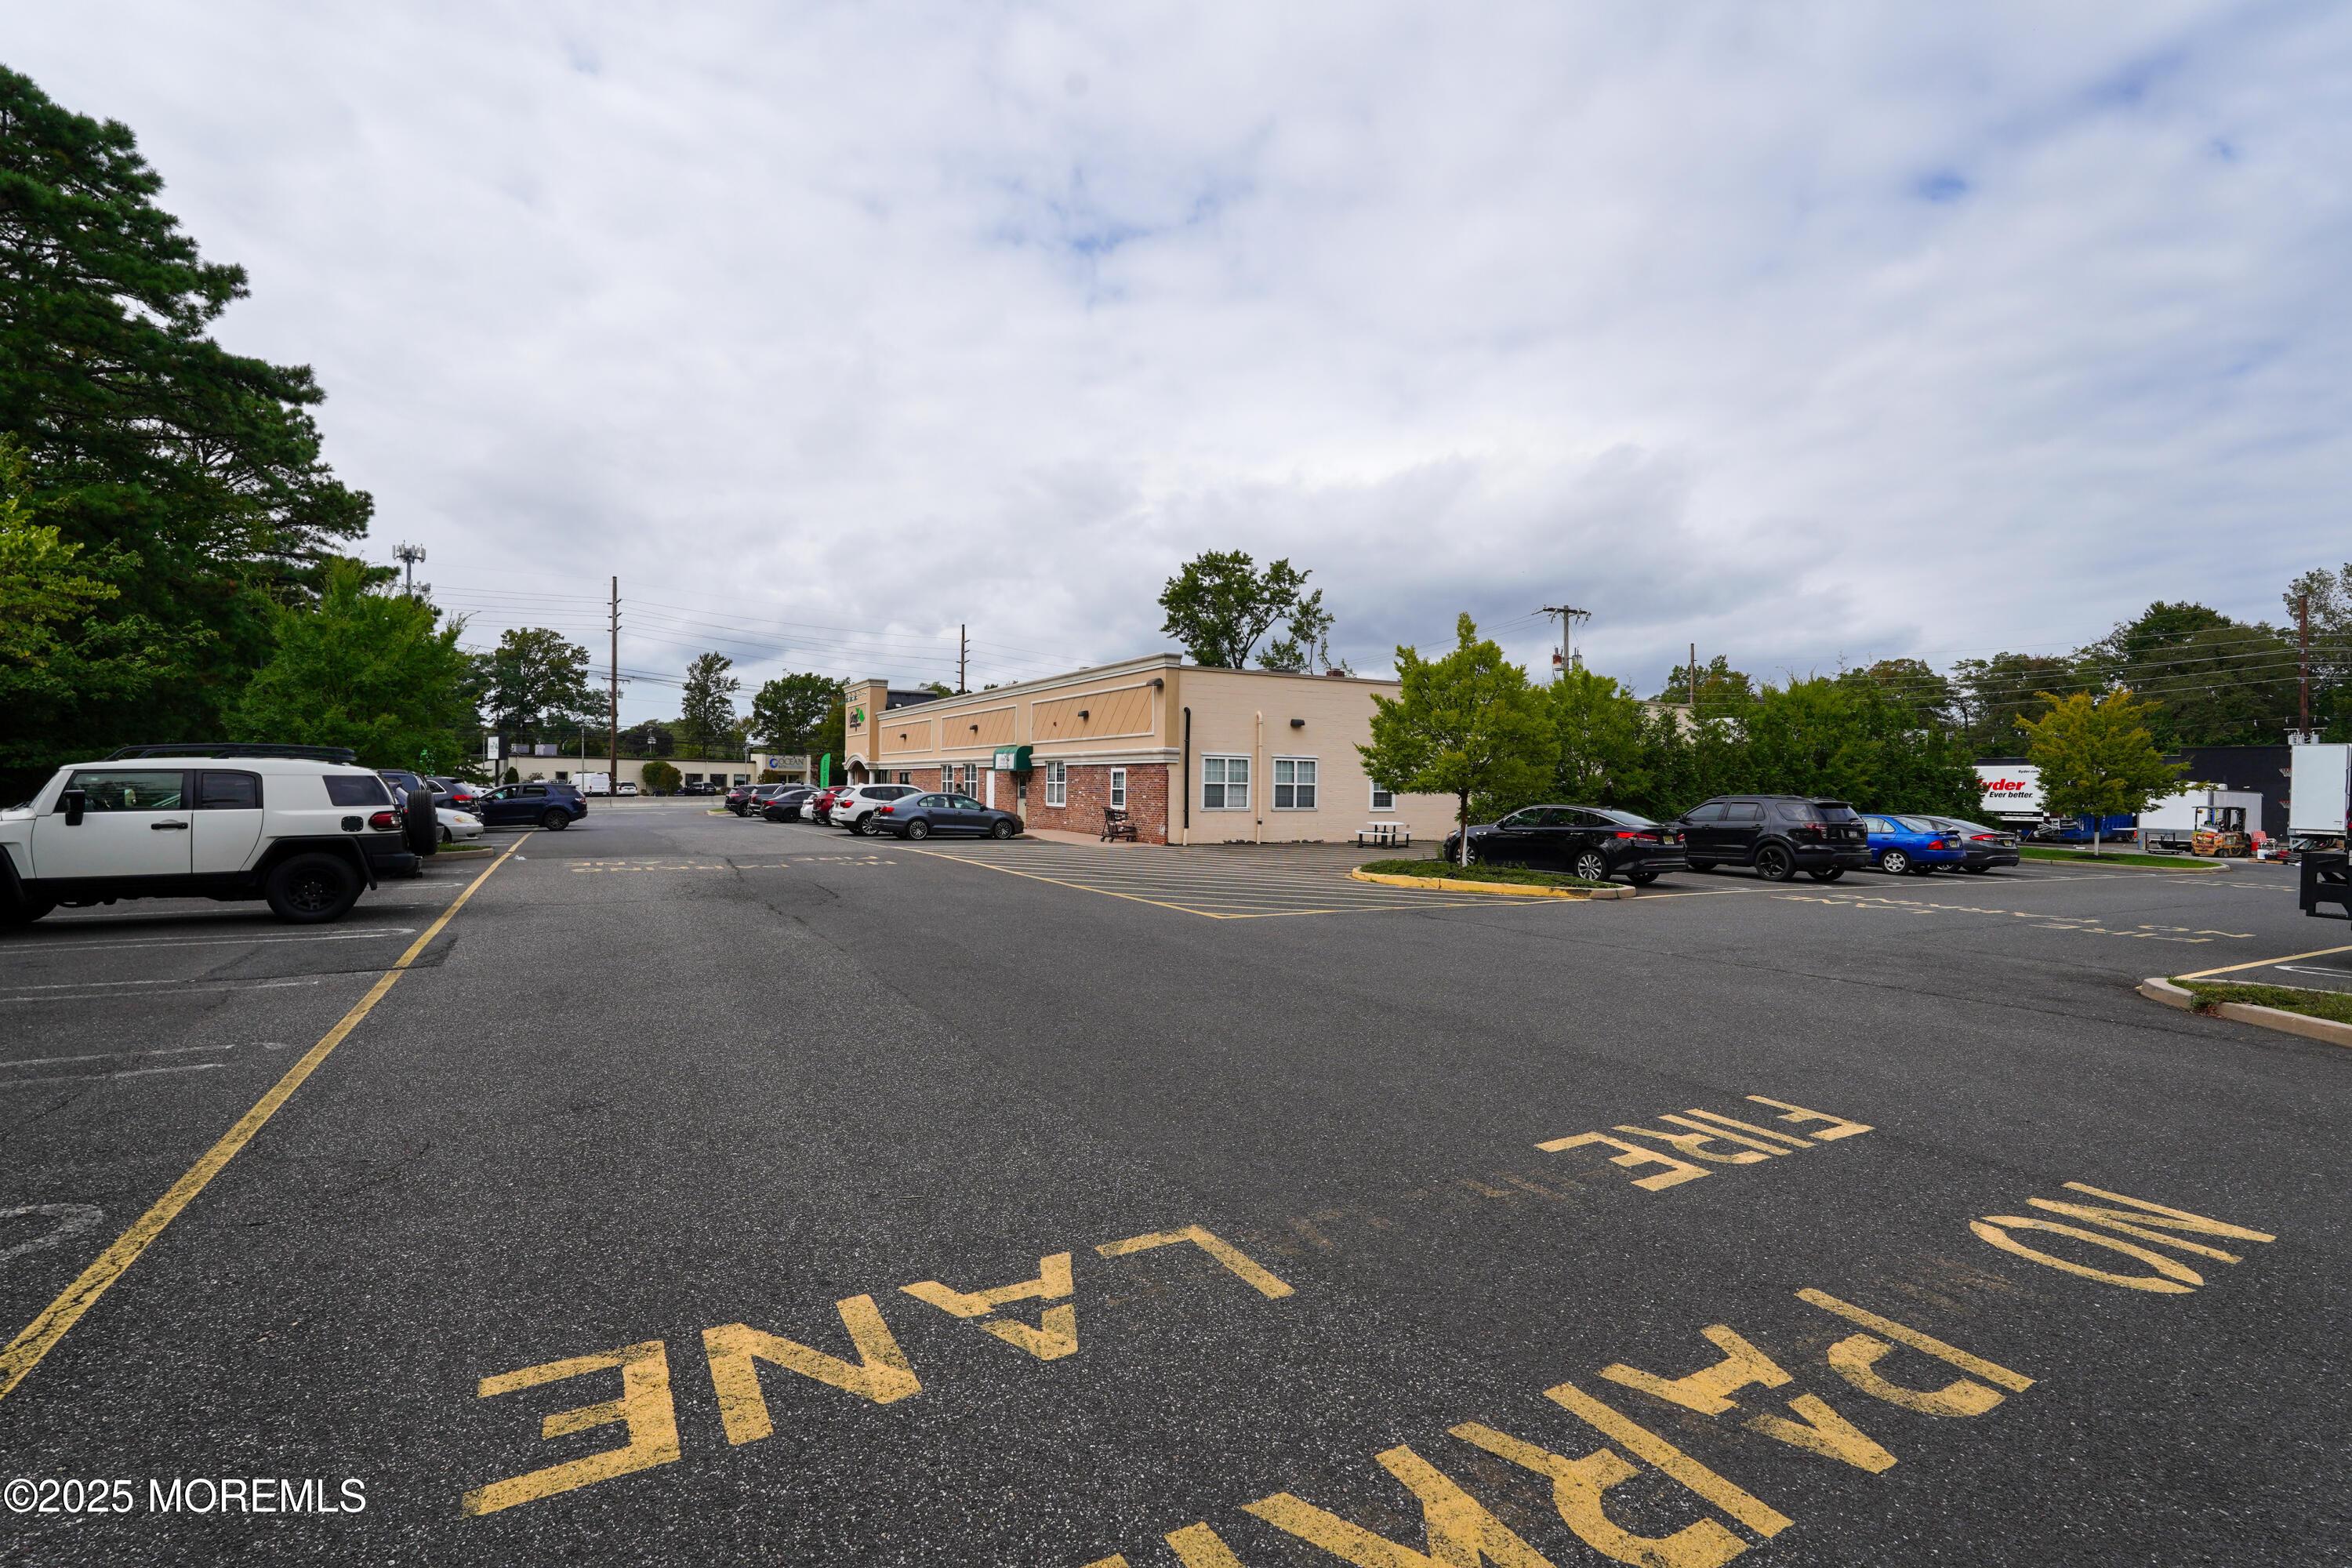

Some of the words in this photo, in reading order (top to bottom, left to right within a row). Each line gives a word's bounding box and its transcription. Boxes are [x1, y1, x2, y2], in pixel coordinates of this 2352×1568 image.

[1534, 1094, 1876, 1192] FIRE
[1969, 1181, 2278, 1294] NO
[461, 1225, 1294, 1518] LANE
